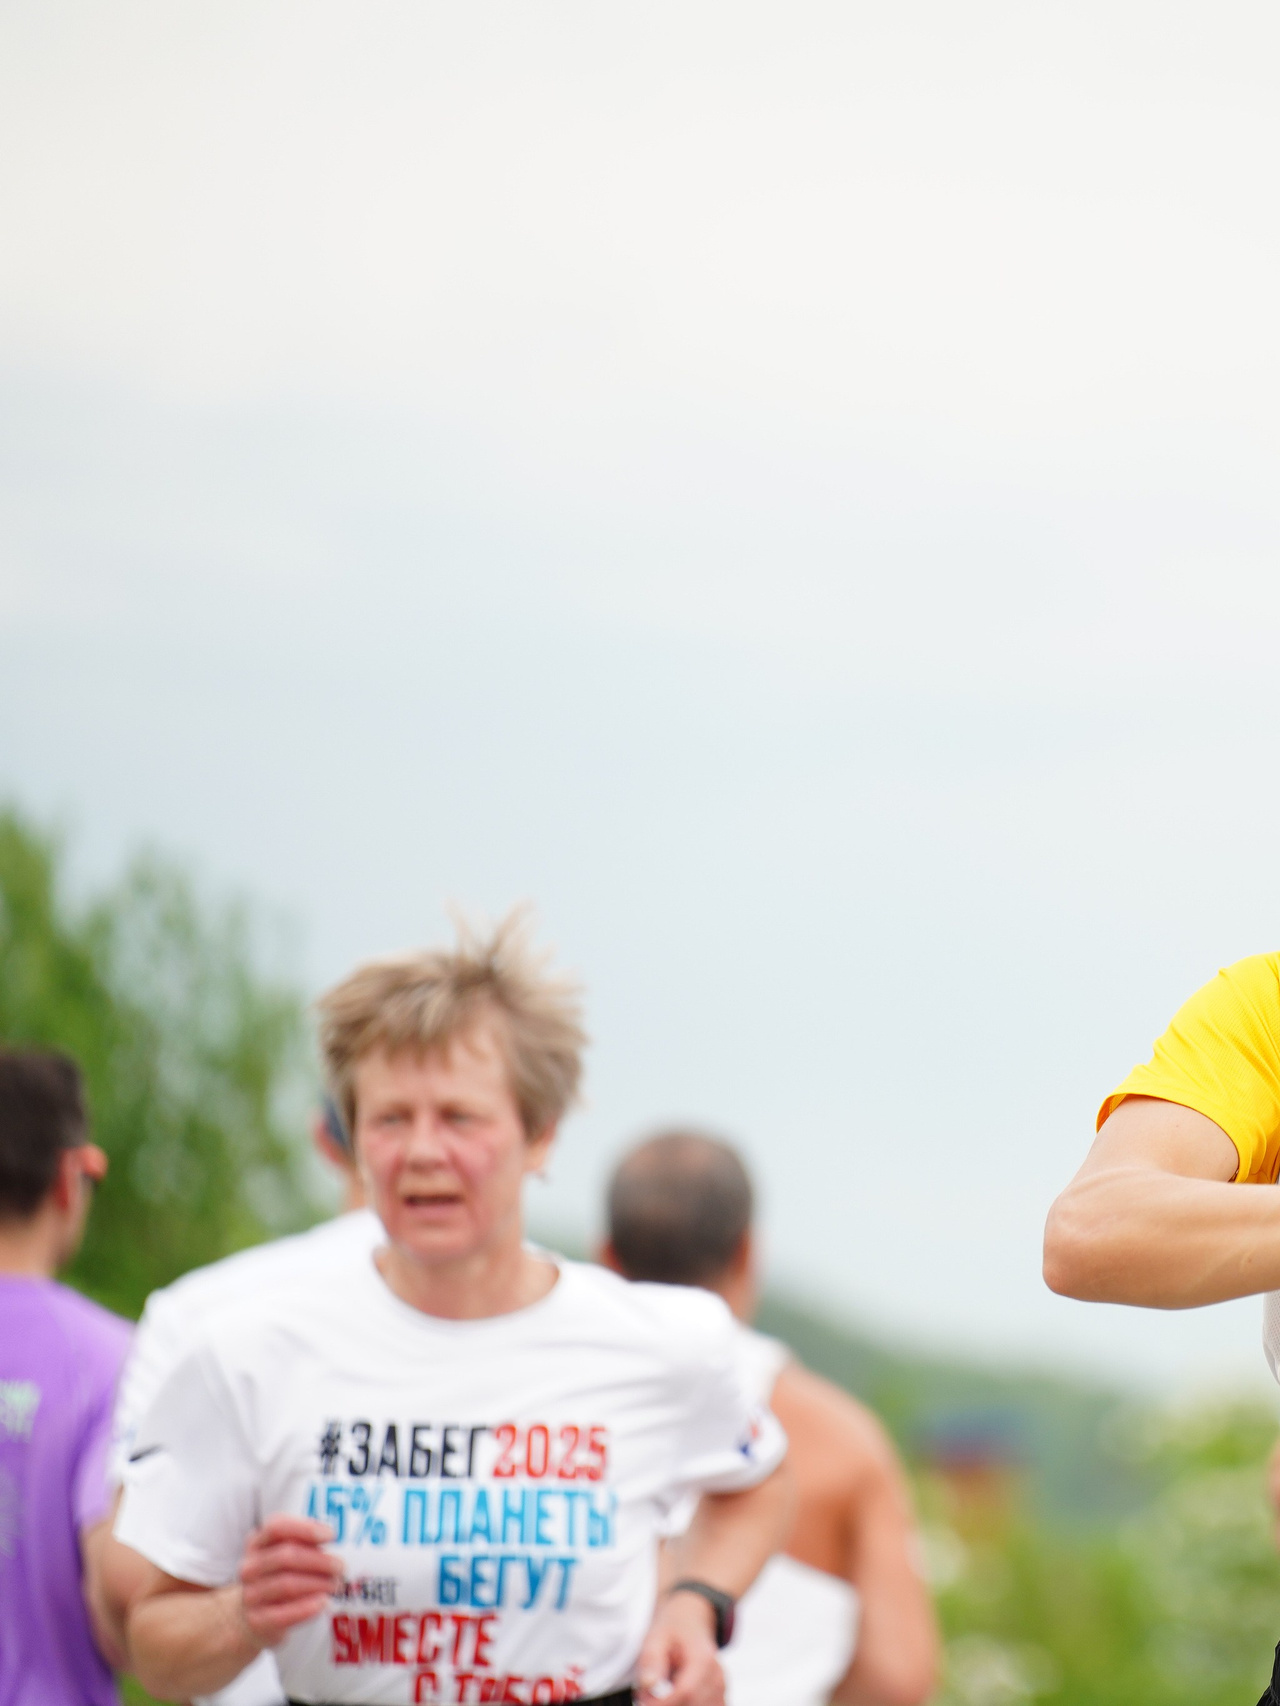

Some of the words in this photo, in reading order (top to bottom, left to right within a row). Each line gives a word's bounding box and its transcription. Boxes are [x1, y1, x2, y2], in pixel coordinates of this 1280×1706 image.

[319, 1421, 607, 1481] #ЗАБЕГ2025
[402, 1486, 615, 1548] ПЛАНЕТЫ
[438, 1555, 578, 1610] БЕГУТ
